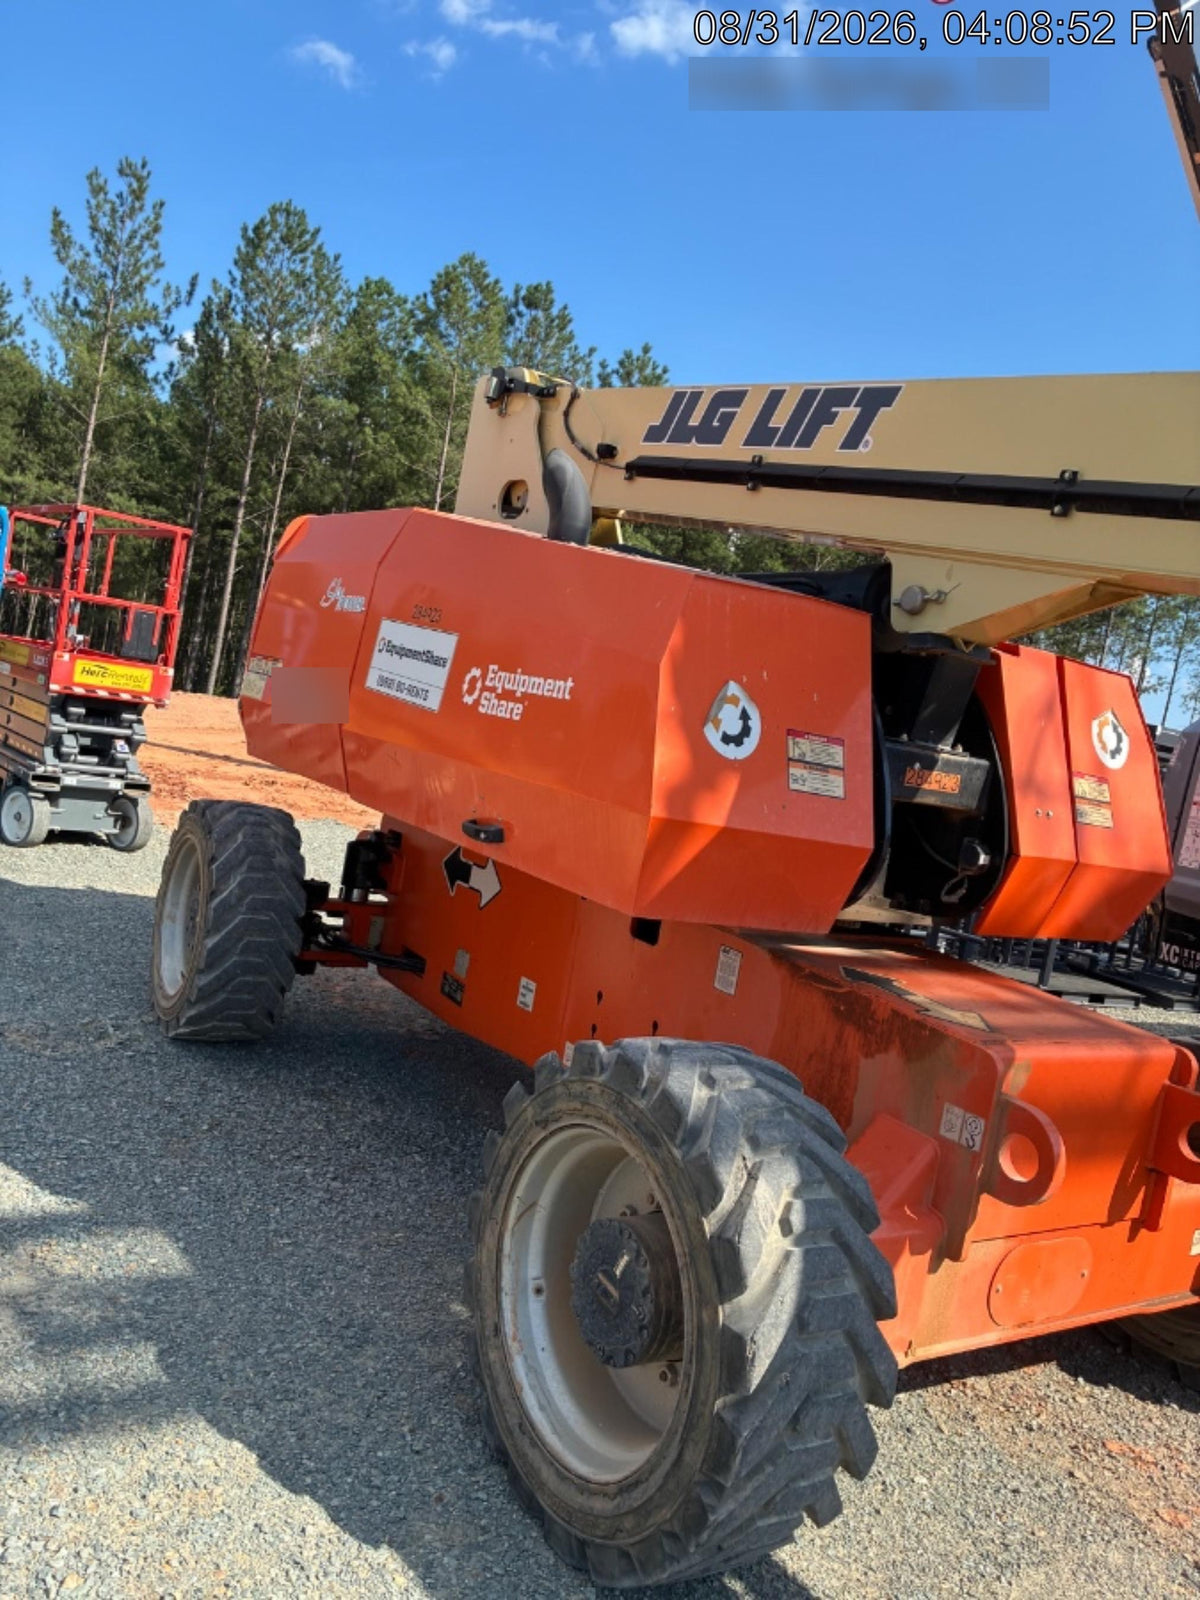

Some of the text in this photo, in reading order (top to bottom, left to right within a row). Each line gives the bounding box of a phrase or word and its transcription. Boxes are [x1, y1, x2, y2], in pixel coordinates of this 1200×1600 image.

[640, 387, 751, 447] JLG
[386, 640, 449, 668] EquipmentShare
[485, 664, 575, 700] Equipment
[478, 691, 524, 721] Share
[906, 768, 960, 792] 284923
[1159, 941, 1180, 965] XC
